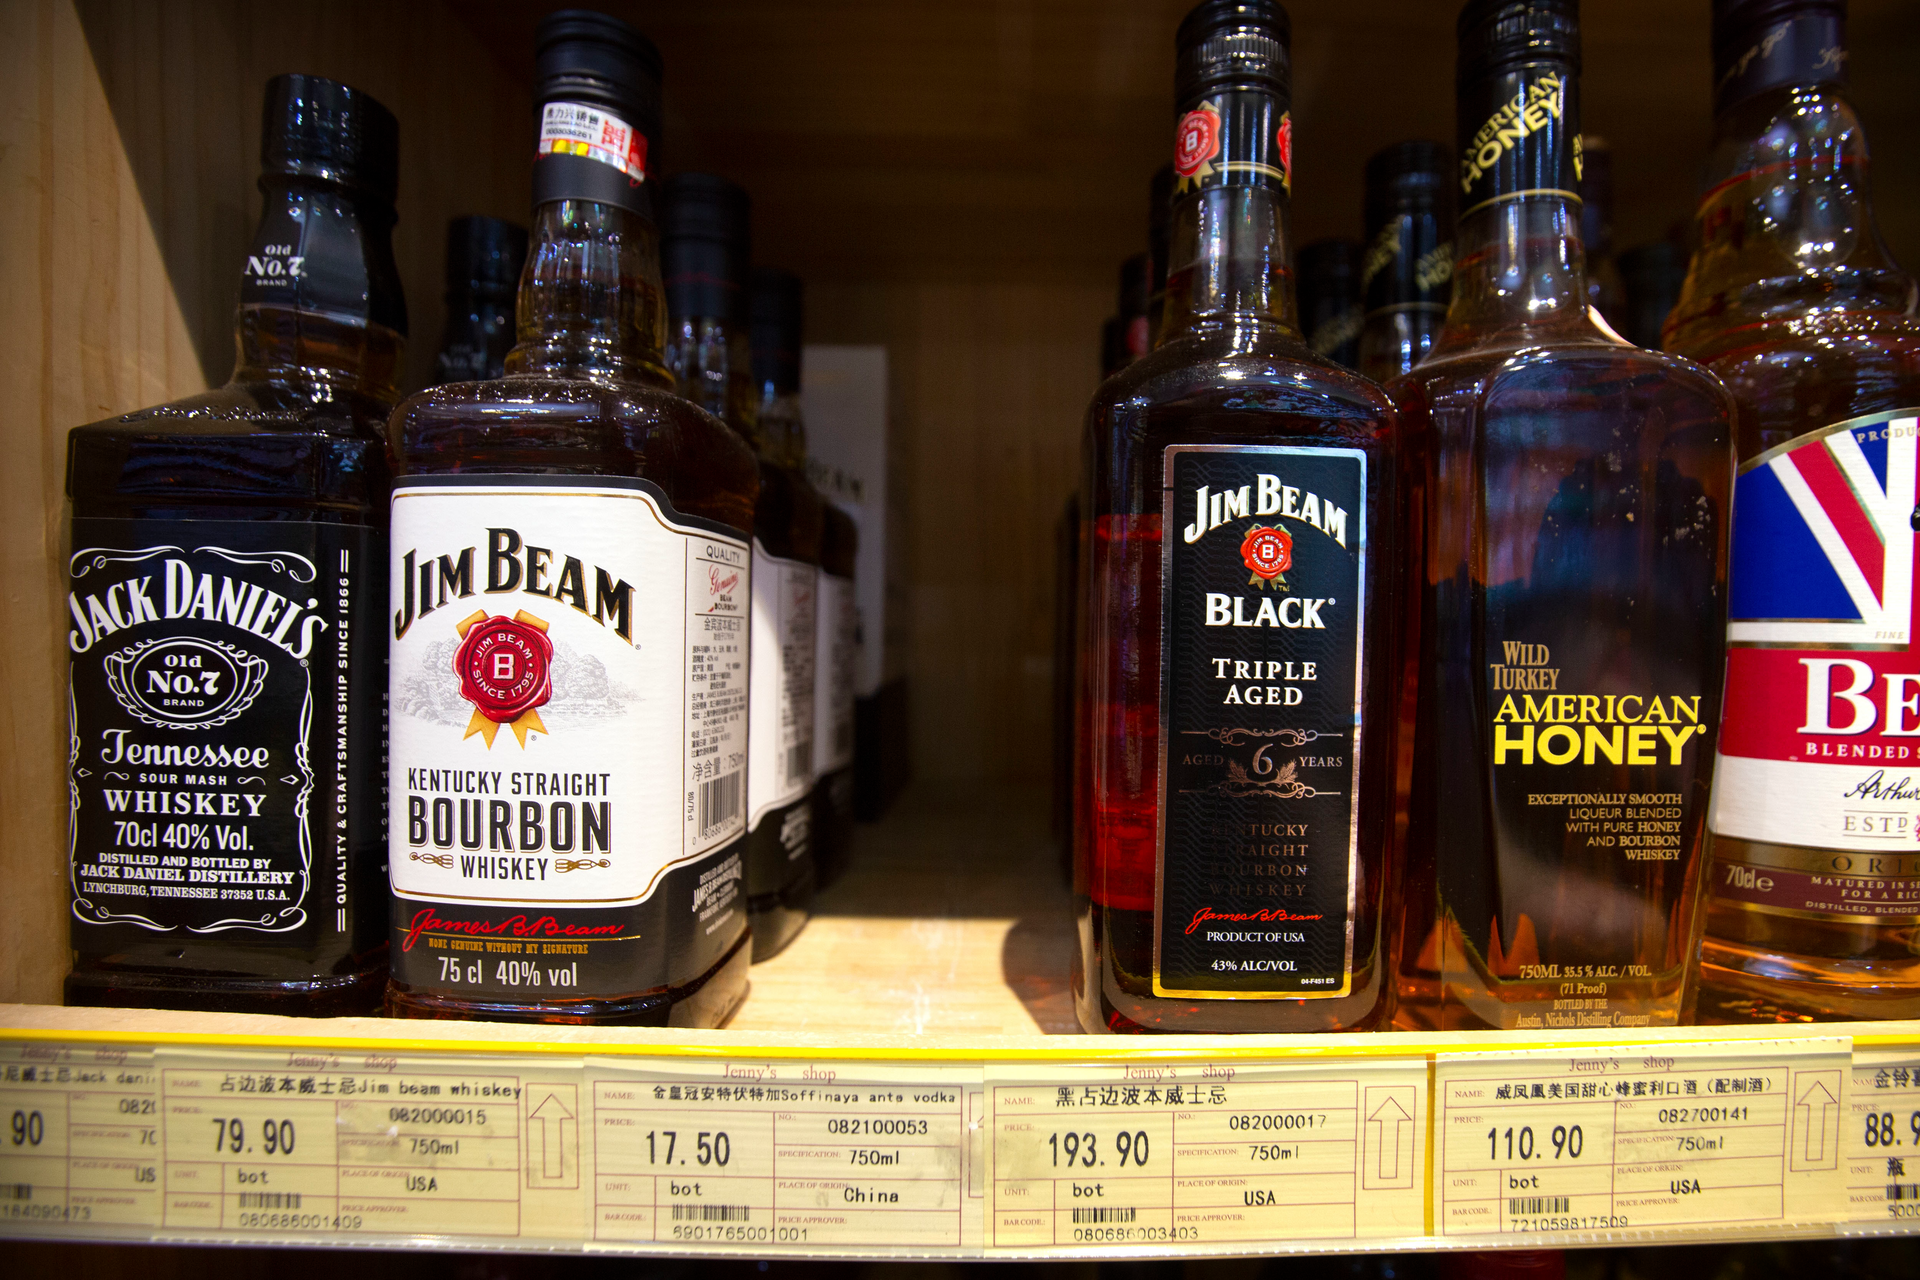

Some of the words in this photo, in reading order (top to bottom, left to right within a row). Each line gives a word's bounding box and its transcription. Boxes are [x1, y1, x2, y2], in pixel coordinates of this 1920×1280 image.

[1461, 71, 1560, 170] AMERICAN
[1461, 91, 1561, 194] HONEY
[264, 244, 292, 256] Old
[244, 255, 305, 277] No.7
[256, 279, 287, 287] BRAND
[1856, 427, 1920, 443] PRODU
[1184, 485, 1252, 545] JIM
[1255, 473, 1348, 549] BEAM
[706, 545, 740, 563] QUALITY
[1262, 544, 1275, 559] B
[339, 577, 350, 614] 1866
[395, 546, 476, 641] JIM
[484, 527, 637, 647] BEAM
[69, 575, 161, 653] JACK
[164, 559, 329, 660] DANIEL'S
[1205, 593, 1327, 629] BLACK
[1875, 631, 1905, 639] FINE
[338, 620, 349, 669] SINCE
[476, 637, 494, 658] JIM
[498, 633, 533, 659] BEAM
[1503, 641, 1550, 666] WILD
[164, 654, 202, 668] Old
[493, 653, 515, 680] B
[1212, 658, 1318, 681] TRIPLE
[146, 670, 221, 695] No.7
[473, 669, 505, 699] SINCE
[511, 671, 534, 697] 1795
[1490, 663, 1560, 691] TURKEY
[163, 699, 205, 707] BRAND
[1223, 684, 1304, 706] AGED
[1493, 694, 1701, 723] AMERICAN
[101, 728, 270, 769] Tennessee
[337, 675, 349, 814] CRAFTSMANSHIP
[1494, 725, 1697, 766] HONEY
[1805, 742, 1909, 759] BLENDED
[1182, 754, 1224, 766] AGED
[1252, 743, 1274, 775] 6
[1300, 756, 1343, 767] YEARS
[139, 773, 177, 785] SOUR
[185, 774, 228, 786] MASH
[408, 767, 501, 795] KENTUCKY
[511, 772, 611, 796] STRAIGHT
[103, 789, 267, 817] WHISKEY
[1528, 794, 1627, 805] EXCEPTIONALLY
[1629, 794, 1682, 804] SMOOTH
[1570, 808, 1622, 820] LIQUEUR
[1626, 808, 1681, 818] BLENDED
[336, 819, 347, 829] &
[408, 795, 612, 854] BOURBON
[1566, 822, 1599, 833] WITH
[1604, 822, 1634, 832] PURE
[1638, 822, 1681, 832] HONEY
[114, 820, 157, 847] 70cl
[162, 822, 210, 850] 40%
[216, 824, 254, 851] Vol.
[1587, 836, 1615, 846] AND
[1619, 836, 1681, 846] BOURBON
[99, 853, 159, 866] DISTILLED
[161, 855, 188, 867] AND
[190, 856, 250, 868] BOTTLED
[252, 858, 272, 870] BY
[1626, 850, 1681, 860] WHISKEY
[80, 864, 120, 879] JACK
[123, 866, 185, 882] DANIEL
[189, 868, 295, 885] DISTILLERY
[336, 834, 347, 904] QUALITY
[460, 855, 549, 881] WHISKEY
[1726, 864, 1756, 889] 70cl
[82, 881, 150, 898] LYNCHBURG,
[150, 884, 218, 899] TENNESSEE
[220, 887, 254, 900] 37352
[255, 889, 291, 901] U.S.A.
[1209, 884, 1307, 896] WHISKEY
[1812, 876, 1885, 889] MATURED
[1841, 889, 1872, 900] FOR
[1875, 905, 1918, 915] BLENDED
[402, 908, 500, 952] James
[530, 915, 624, 936] Beam
[1206, 932, 1264, 942] PRODUCT
[1265, 932, 1281, 942] OF
[1283, 932, 1305, 942] USA
[428, 938, 448, 949] NONE
[450, 940, 484, 952] GENUINE
[486, 942, 522, 954] WITHOUT
[525, 943, 539, 954] MY
[542, 944, 589, 955] SIGNATURE
[438, 956, 461, 983] 75
[467, 959, 483, 984] cl
[496, 960, 541, 987] 40%
[548, 962, 578, 987] vol
[1211, 960, 1238, 972] 43%
[1240, 961, 1298, 972] ALC/VOL
[1519, 964, 1562, 978] 750ML
[1564, 966, 1583, 978] 35.5
[1595, 966, 1618, 977] ALC.
[1560, 982, 1574, 996] (71
[1576, 982, 1607, 995] Proof)
[1554, 999, 1584, 1010] BOTTLED
[1585, 999, 1594, 1009] BY
[1595, 999, 1608, 1010] THE
[1516, 1013, 1543, 1029] Austin,
[1545, 1012, 1576, 1027] Nichols
[1577, 1011, 1612, 1028] Distilling
[1614, 1011, 1651, 1027] Company
[287, 1052, 340, 1070] Jenny's
[364, 1054, 397, 1073] shop
[1569, 1057, 1620, 1074] Jenny's
[1643, 1055, 1675, 1072] shop
[723, 1064, 777, 1082] Jenny's
[802, 1064, 836, 1082] shop
[1123, 1065, 1177, 1082] Jenny's
[1202, 1063, 1236, 1081] shop
[400, 1079, 441, 1095] beam
[451, 1081, 521, 1099] whiskey
[913, 1092, 956, 1103] vodka
[1056, 1084, 1228, 1107] 黑占边波本威士忌
[389, 1107, 487, 1125] 082000015
[1229, 1115, 1327, 1130] 082000017
[1658, 1107, 1748, 1123] 082700141
[212, 1118, 296, 1154] 79.90
[827, 1119, 928, 1135] 082100053
[411, 1138, 460, 1155] 750ml
[646, 1130, 730, 1167] 17.50
[1048, 1130, 1150, 1168] 193.90
[1488, 1124, 1583, 1160] 110.90
[1676, 1135, 1723, 1151] 750ml
[849, 1150, 900, 1166] 750ml
[1248, 1145, 1299, 1160] 750ml
[1887, 1157, 1905, 1176] 瓶
[239, 1169, 269, 1183] bot
[406, 1177, 438, 1192] USA
[1509, 1175, 1539, 1189] bot
[670, 1180, 702, 1196] bot
[843, 1187, 899, 1203] China
[1073, 1182, 1104, 1197] bot
[1670, 1179, 1701, 1195] USA
[1244, 1190, 1276, 1206] USA
[240, 1213, 362, 1229] 080686001409
[1510, 1216, 1629, 1232] 721059817509
[673, 1225, 808, 1242] 6901765001001
[1074, 1226, 1199, 1241] 080686003403
